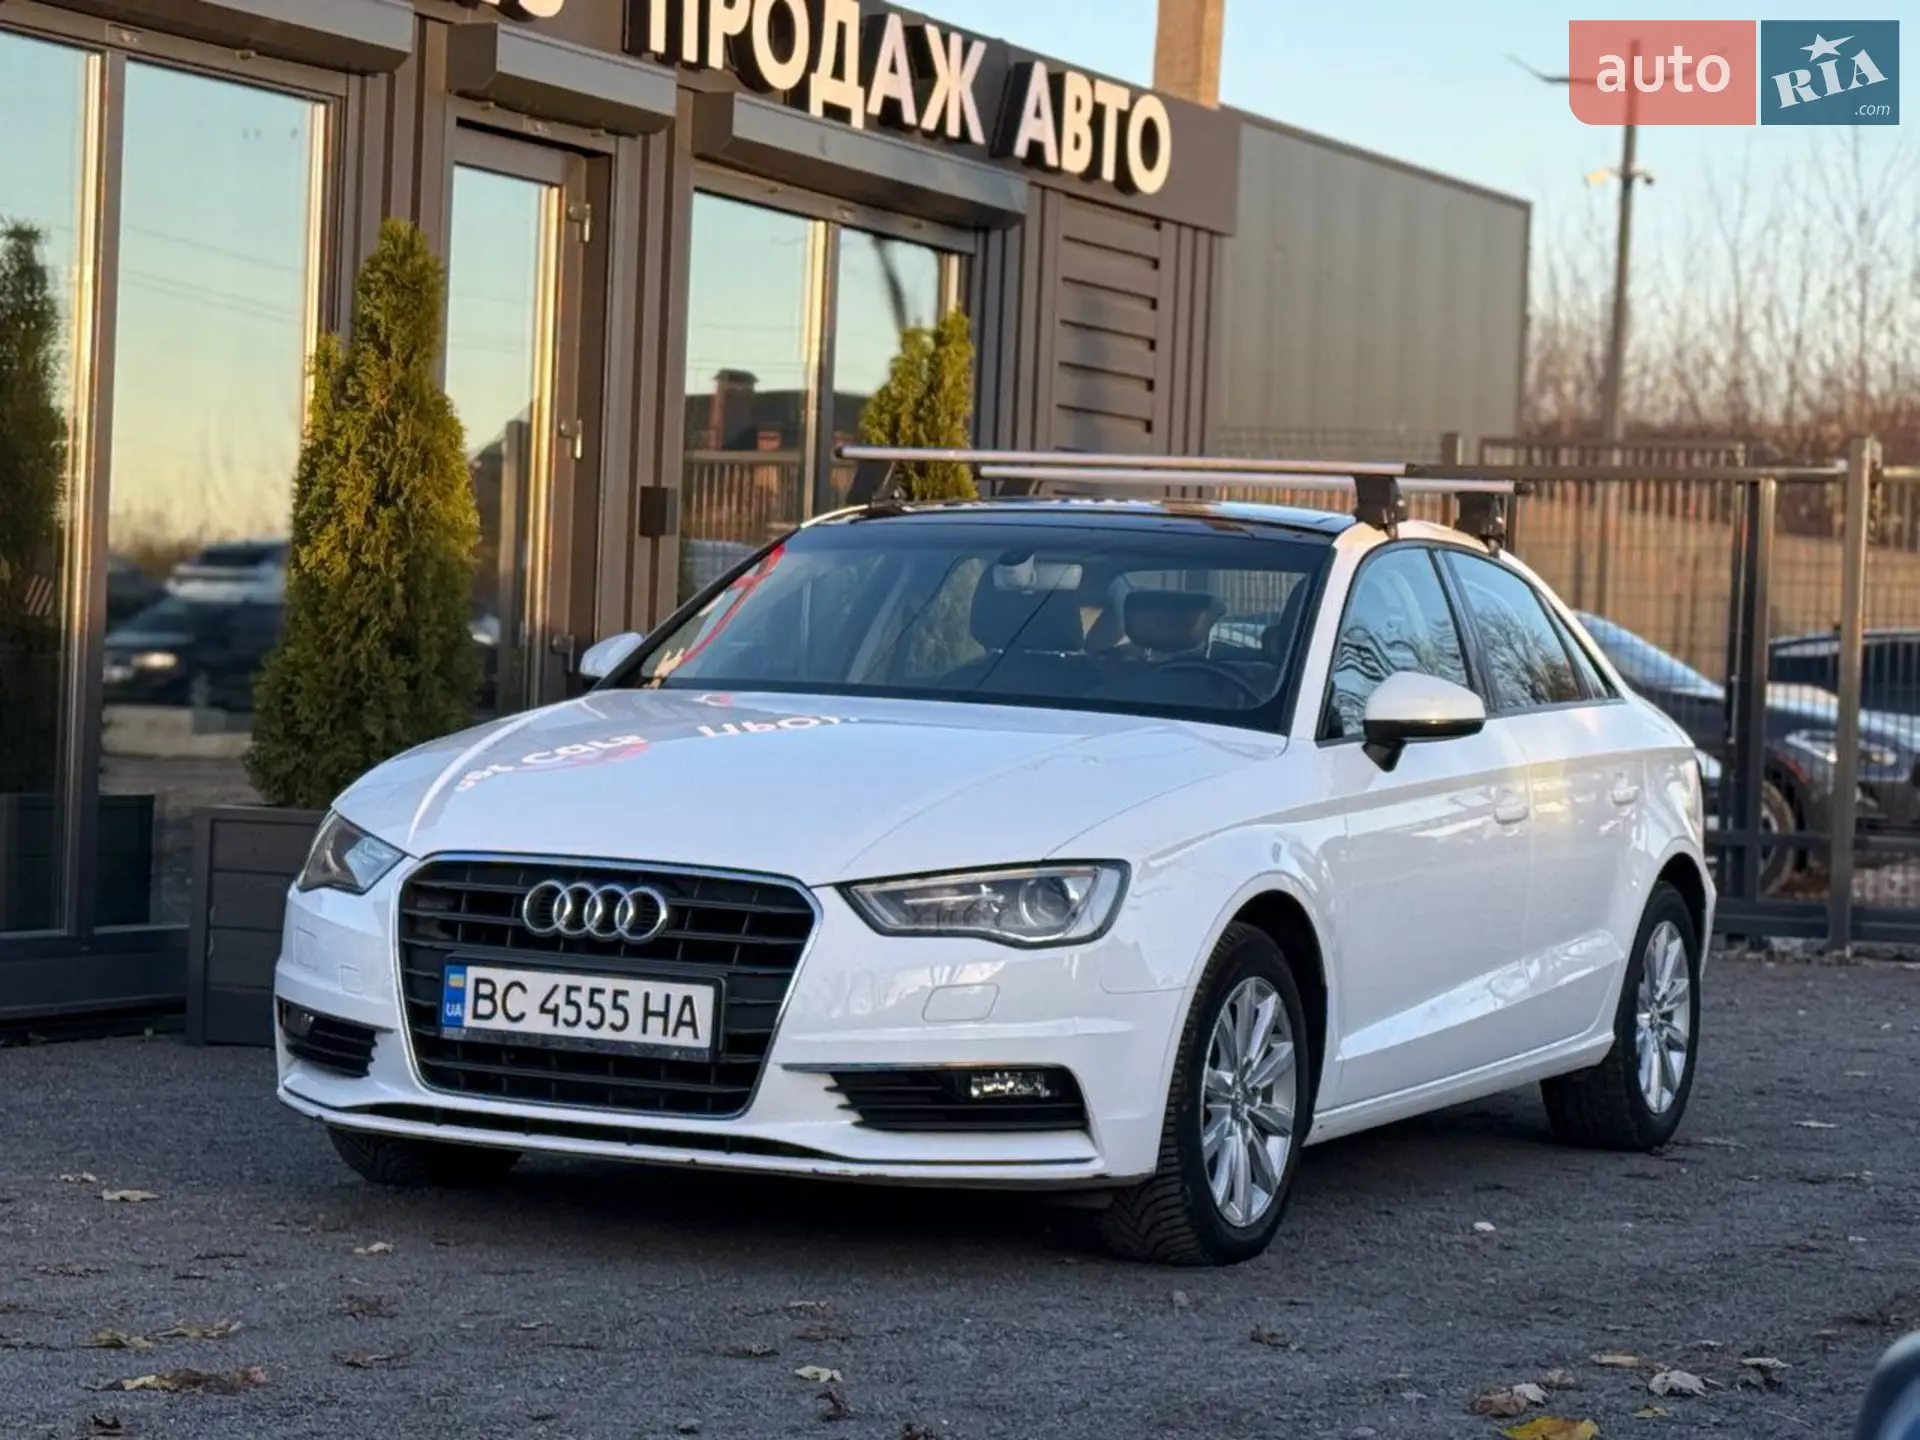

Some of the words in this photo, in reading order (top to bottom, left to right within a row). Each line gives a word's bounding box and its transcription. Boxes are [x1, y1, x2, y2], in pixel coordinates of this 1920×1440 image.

[1013, 60, 1172, 194] АВТО
[446, 1001, 463, 1018] UA
[472, 977, 528, 1023] BC
[539, 984, 630, 1033] 4555
[641, 991, 700, 1040] HA
